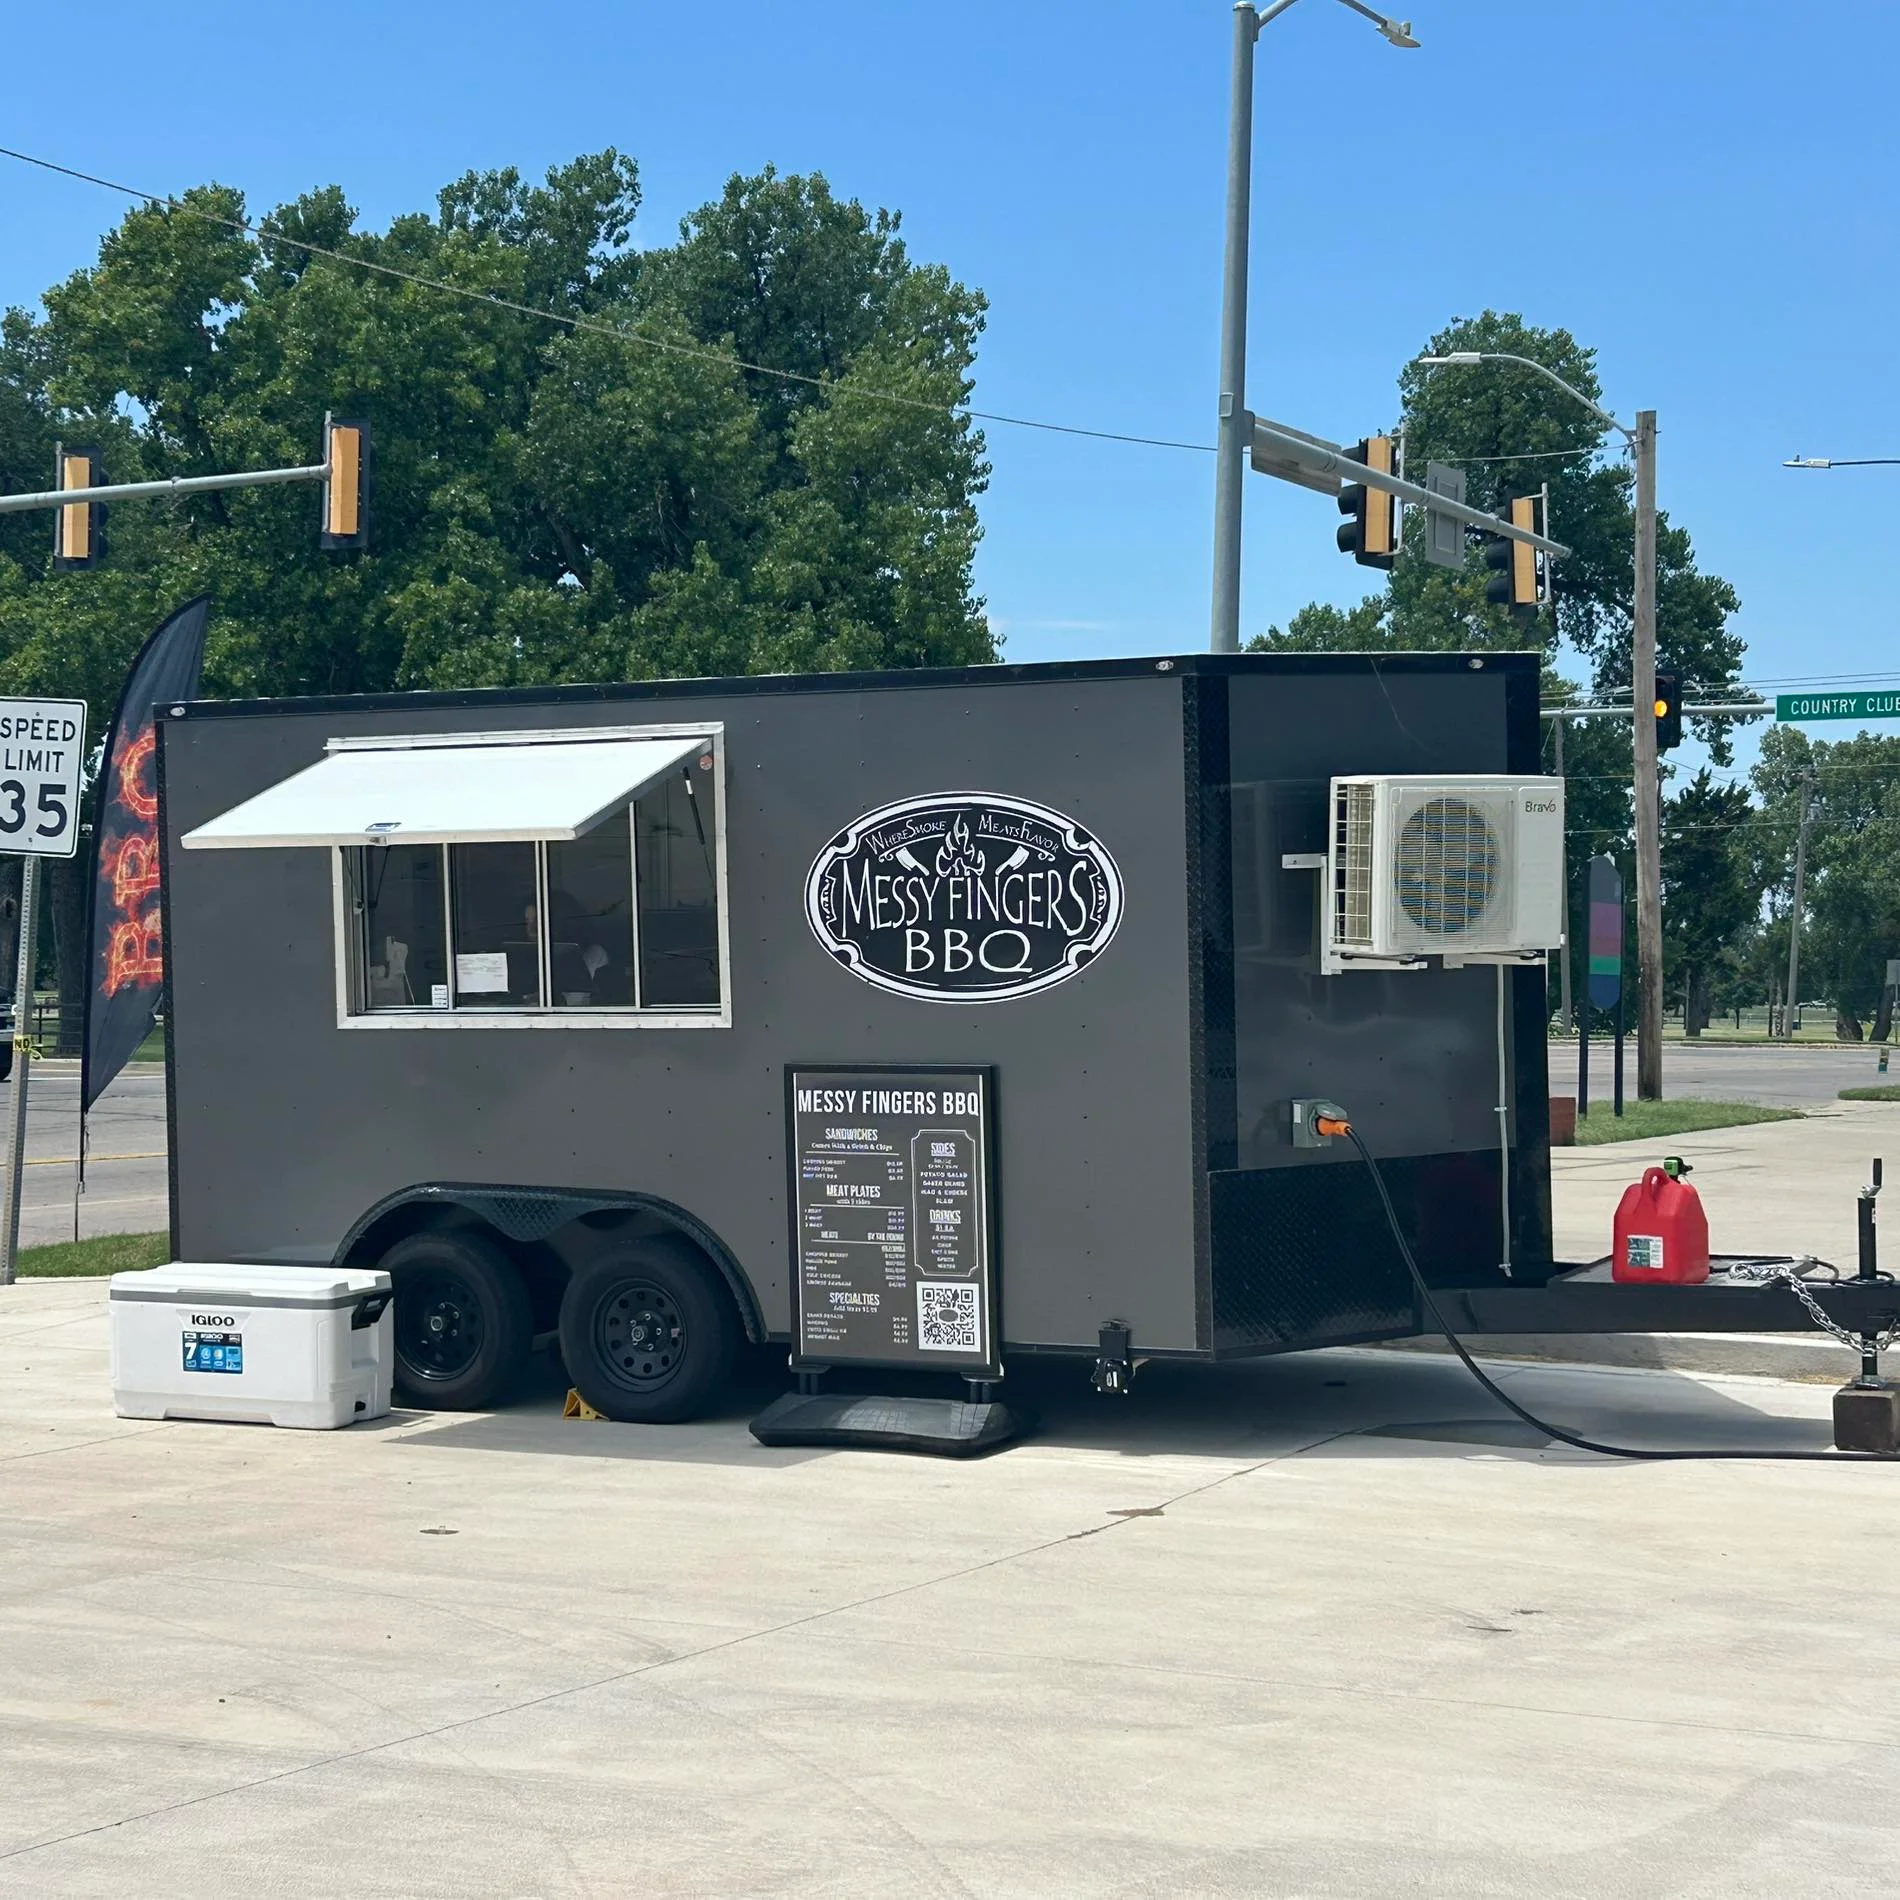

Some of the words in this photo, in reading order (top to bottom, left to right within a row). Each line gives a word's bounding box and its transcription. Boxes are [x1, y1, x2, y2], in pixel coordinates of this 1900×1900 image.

[1791, 699, 1857, 715] COUNTRY
[0, 717, 76, 741] SPEED
[5, 749, 65, 772] LIMIT
[0, 779, 68, 838] 35
[1525, 799, 1556, 813] Bravo
[841, 858, 940, 938] MESSY
[949, 860, 1087, 937] FINGERS
[905, 929, 1033, 973] BBQ
[798, 1089, 857, 1113] MESSY
[862, 1090, 936, 1115] FINGERS
[942, 1092, 979, 1116] BBQ
[825, 1128, 878, 1141] SANDWICHES
[931, 1142, 956, 1156] SIDES
[826, 1185, 849, 1197] MEAT
[850, 1185, 881, 1198] PLATES
[929, 1209, 961, 1223] DRINKS
[829, 1292, 880, 1306] SPECIALTIES
[191, 1314, 235, 1327] IGLOO
